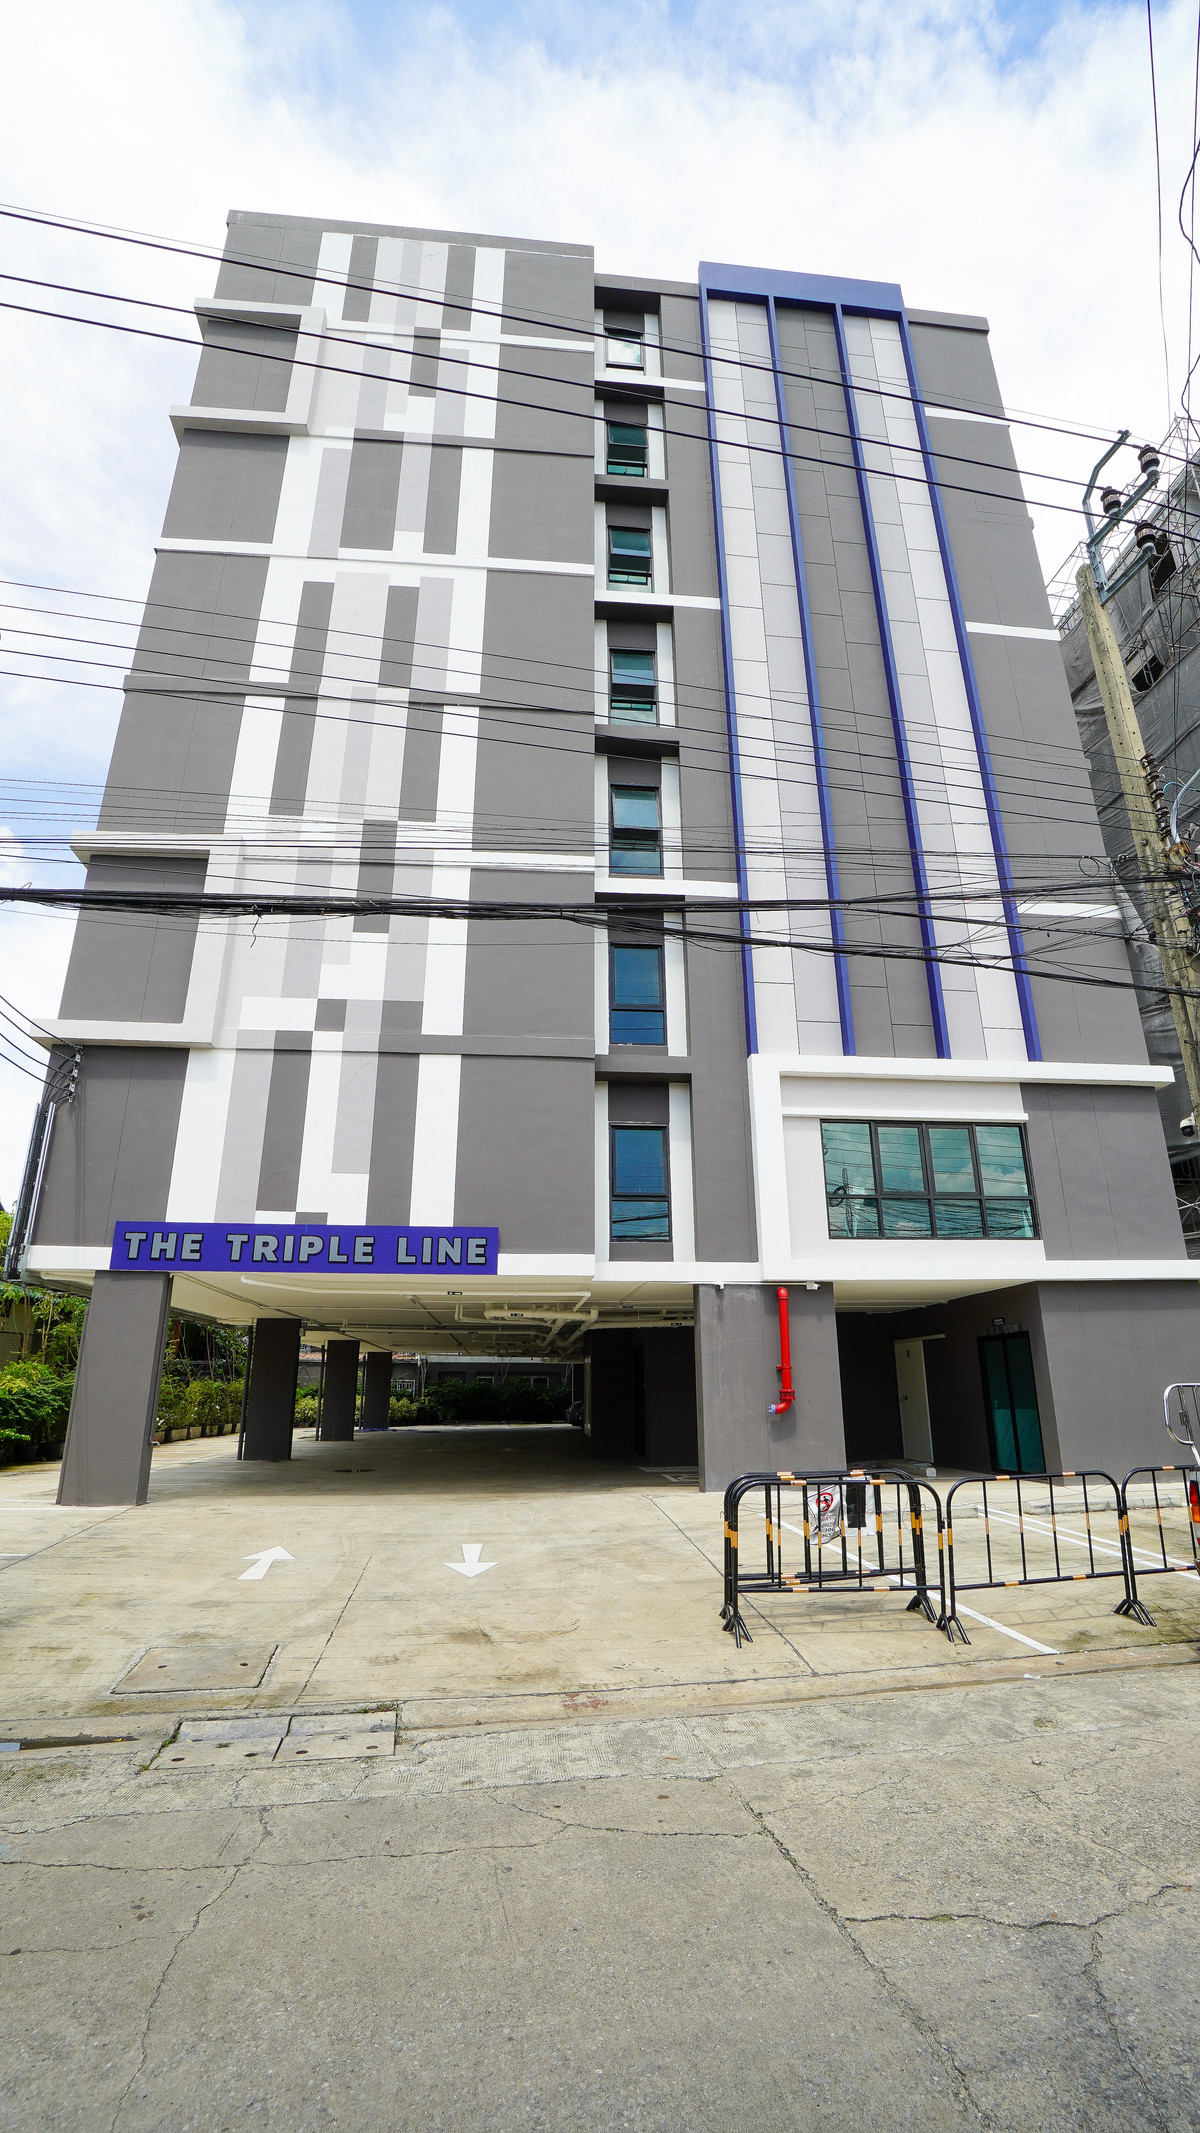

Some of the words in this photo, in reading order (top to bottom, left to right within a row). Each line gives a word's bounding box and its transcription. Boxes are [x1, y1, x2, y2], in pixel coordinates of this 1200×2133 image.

[124, 1231, 203, 1261] THE
[226, 1233, 375, 1263] TRIPLE
[396, 1236, 487, 1265] LINE
